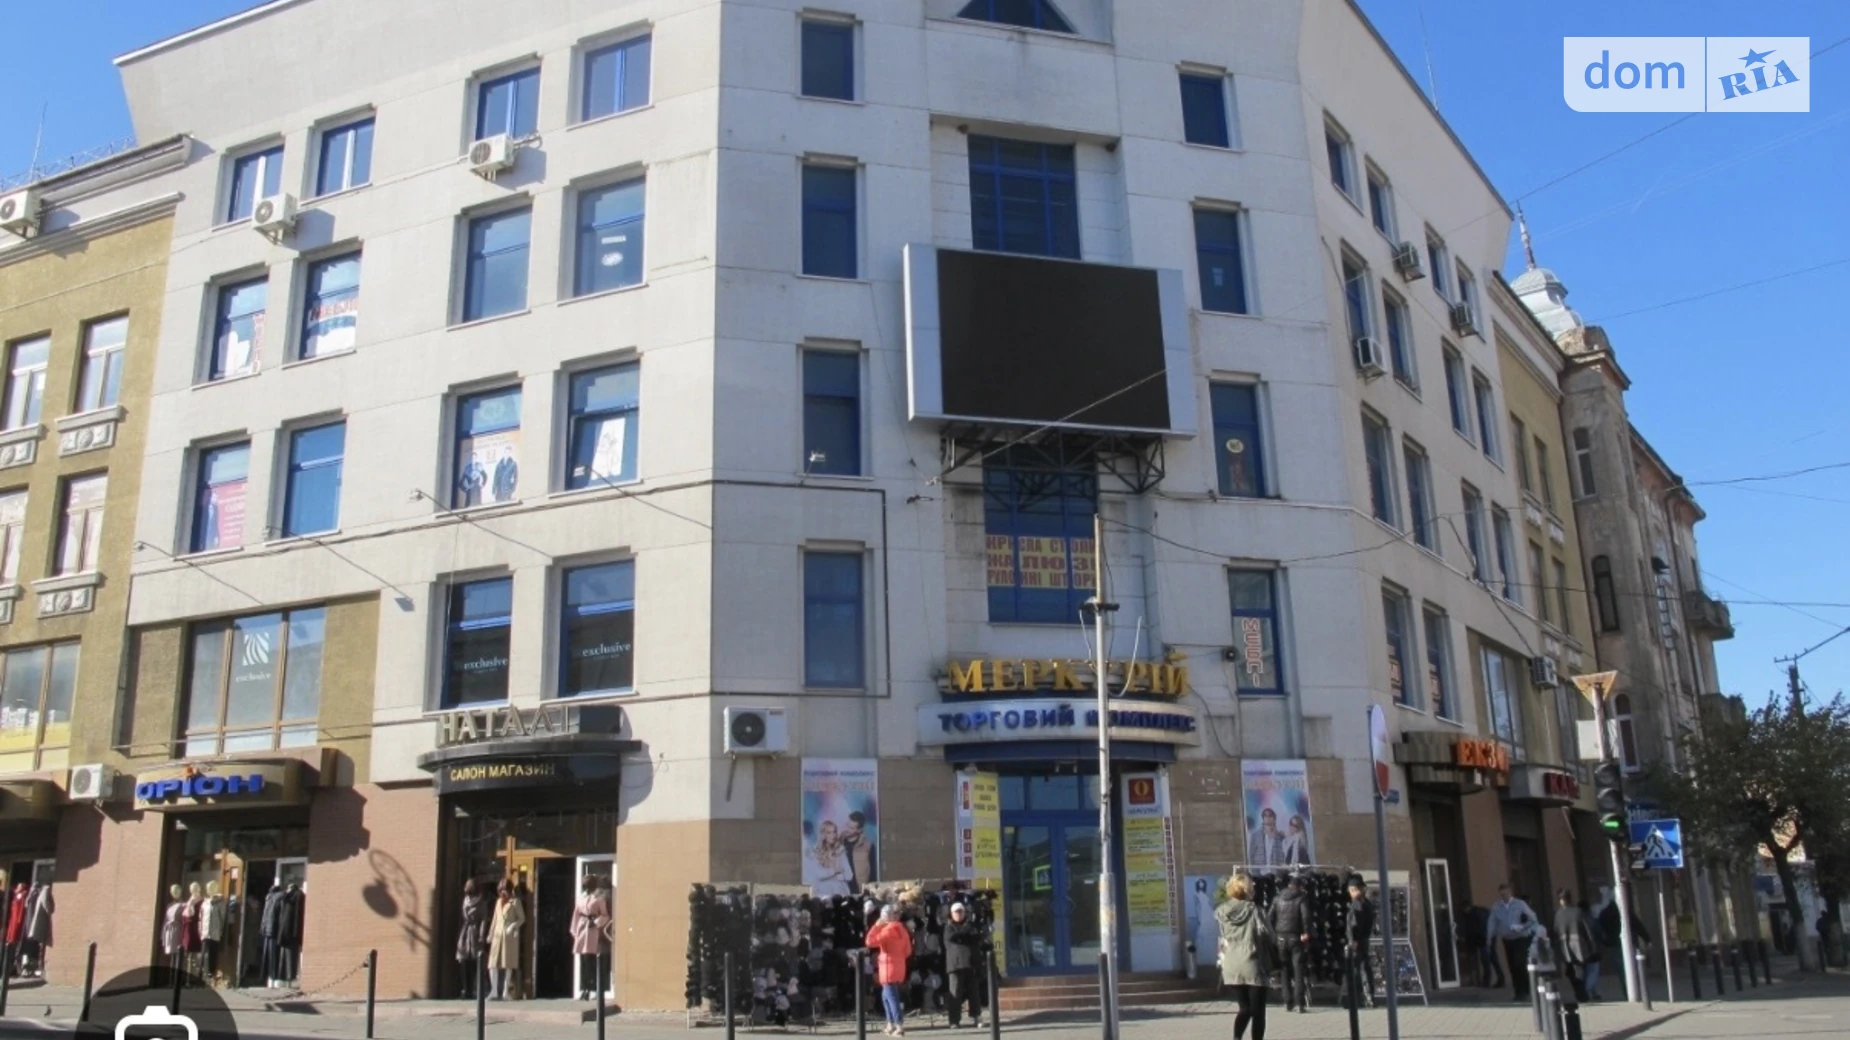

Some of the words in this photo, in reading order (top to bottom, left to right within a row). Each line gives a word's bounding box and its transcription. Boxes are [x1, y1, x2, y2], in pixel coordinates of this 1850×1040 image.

[582, 642, 632, 657] exclusive
[463, 656, 508, 670] exclusive
[938, 704, 1075, 733] ТОРГОВИЙ
[451, 766, 486, 781] САЛОН
[488, 764, 555, 778] МАГАЗИН
[136, 771, 265, 801] ОРІОН
